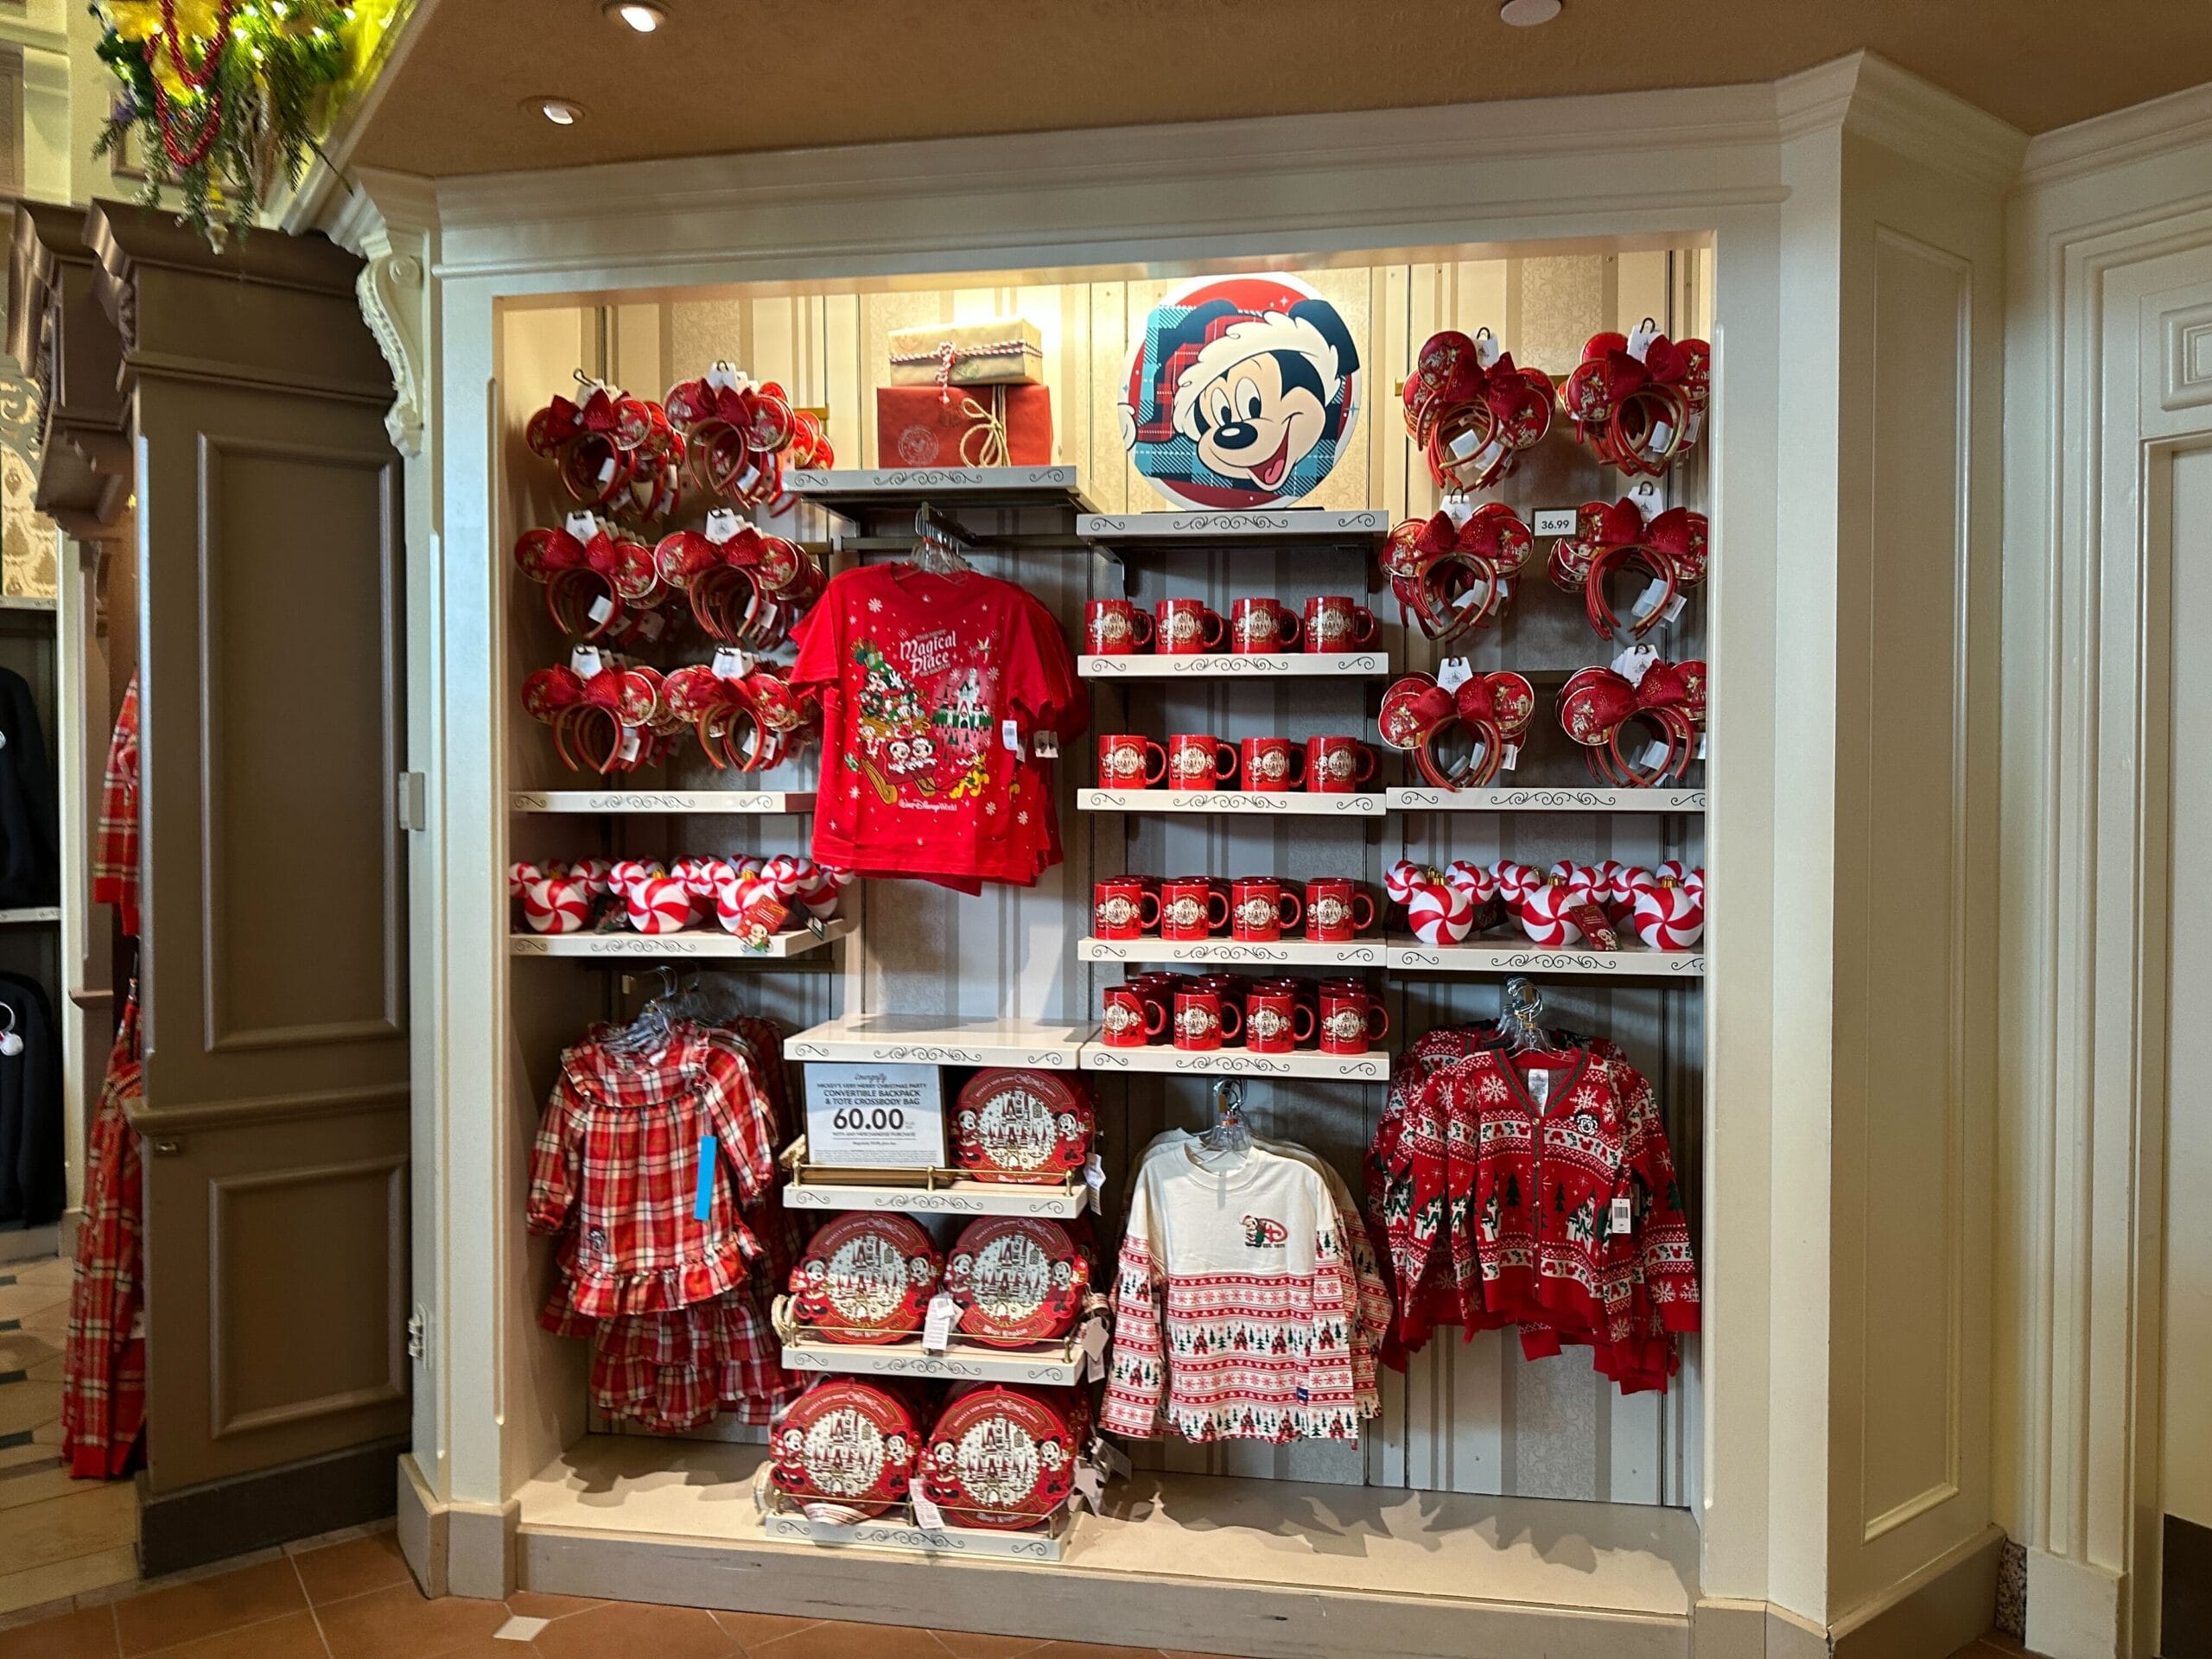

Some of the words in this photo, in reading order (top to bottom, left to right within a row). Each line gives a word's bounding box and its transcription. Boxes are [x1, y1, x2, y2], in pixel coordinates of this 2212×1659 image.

[1541, 519, 1570, 530] 36.99
[899, 630, 957, 661] Magical
[909, 652, 950, 679] Place
[912, 798, 940, 813] Disney
[833, 1108, 905, 1130] 60.00
